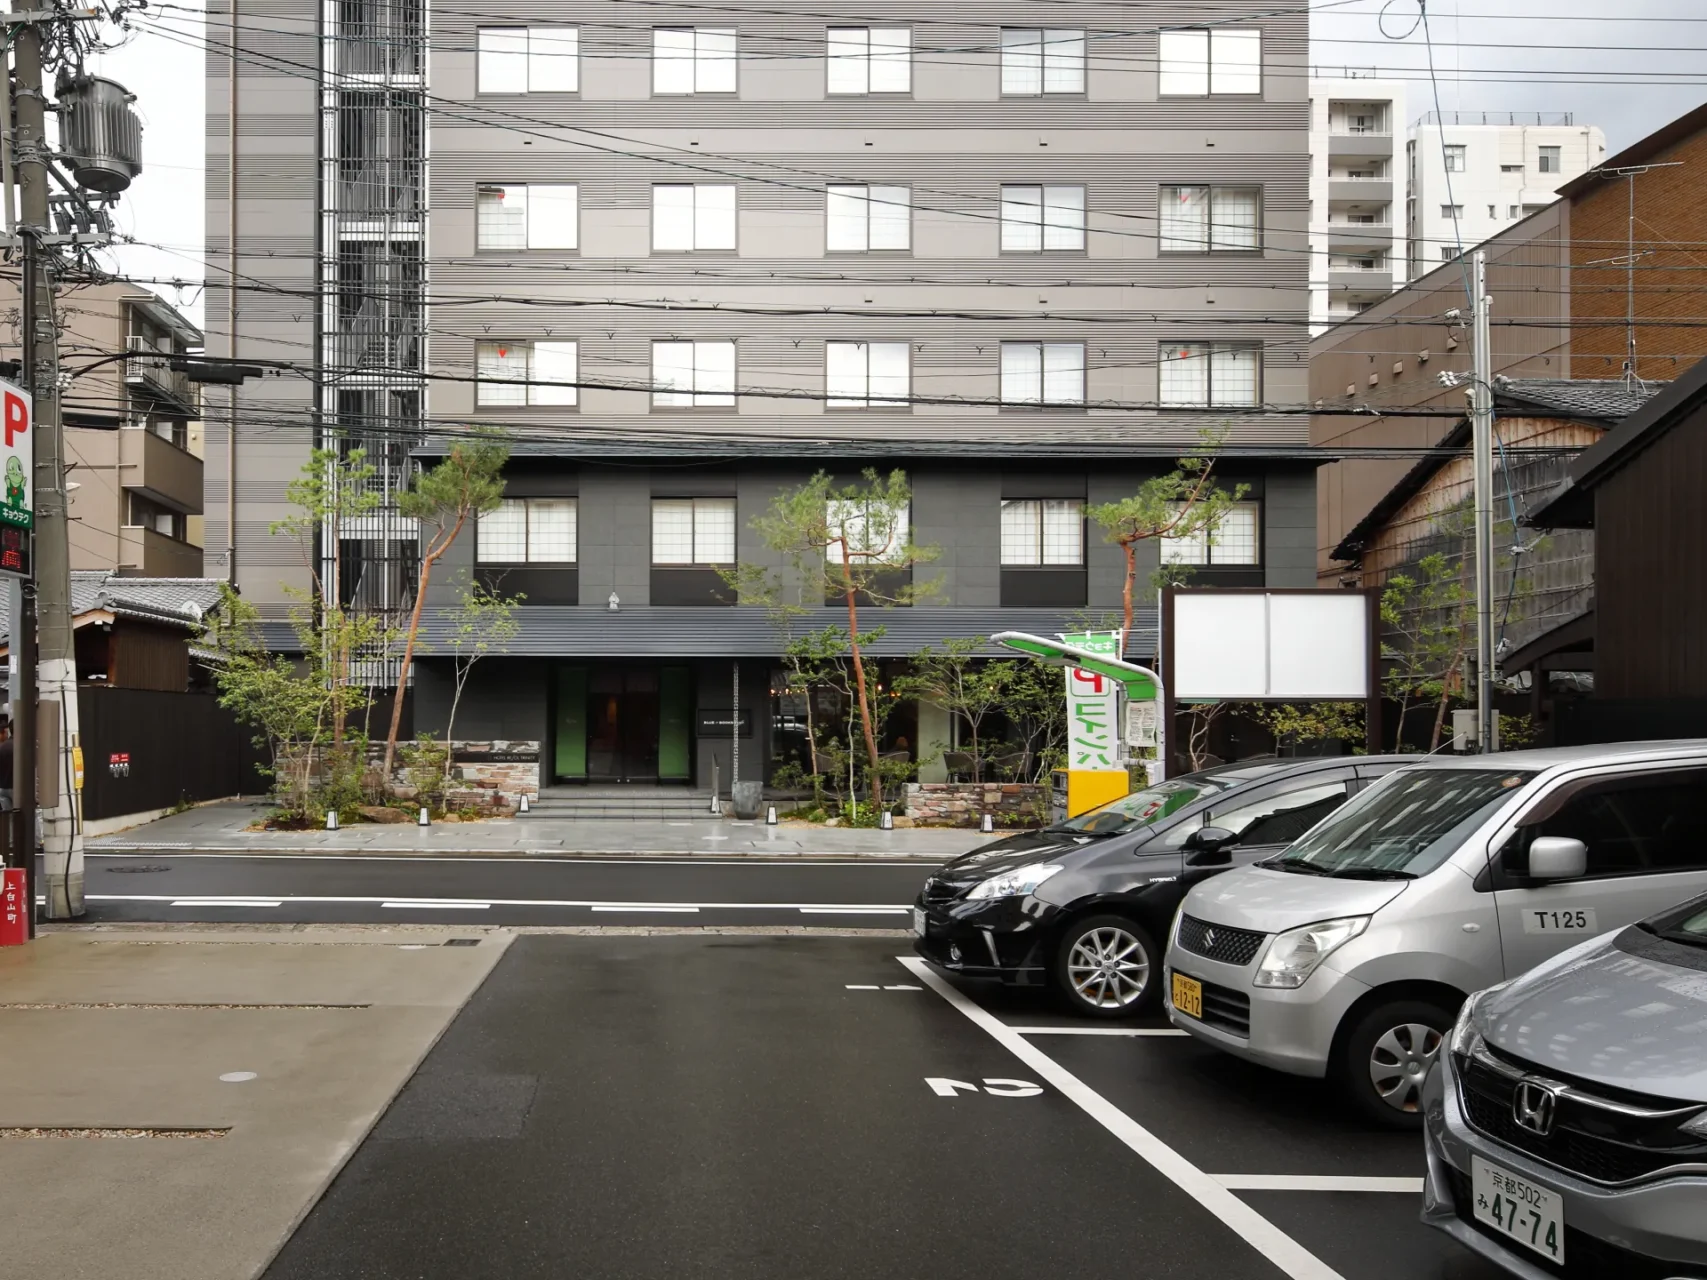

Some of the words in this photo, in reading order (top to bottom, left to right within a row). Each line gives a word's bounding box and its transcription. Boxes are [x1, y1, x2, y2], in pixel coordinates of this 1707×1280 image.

[5, 391, 28, 447] P
[2, 507, 29, 523] キョウテク
[5, 881, 17, 924] 上白山町
[1534, 911, 1586, 928] T125
[1180, 990, 1200, 1015] 12-12
[1492, 1170, 1541, 1209] 京都502
[1477, 1193, 1489, 1209] み
[1492, 1193, 1558, 1256] 47-74
